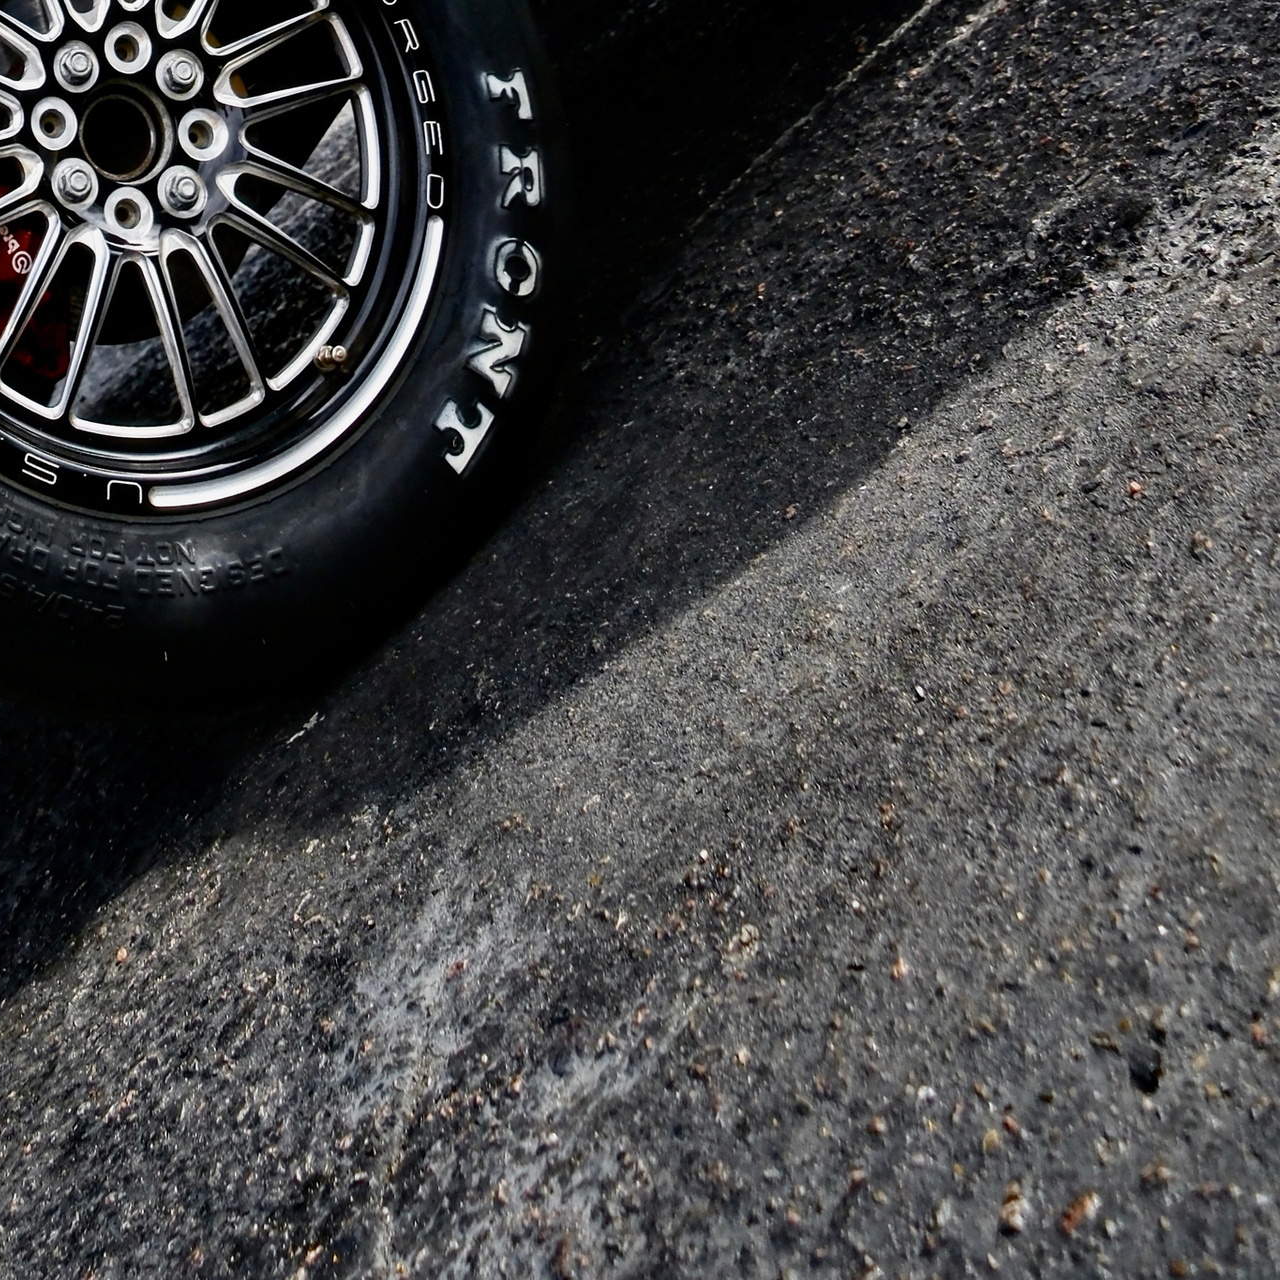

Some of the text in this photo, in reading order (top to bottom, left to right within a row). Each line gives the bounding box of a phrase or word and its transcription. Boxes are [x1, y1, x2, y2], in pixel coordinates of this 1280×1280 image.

[433, 68, 546, 476] FRONT
[69, 532, 126, 565] FOR
[135, 538, 196, 566] NOT
[63, 559, 123, 590] FOR
[134, 545, 290, 597] DESIGNED
